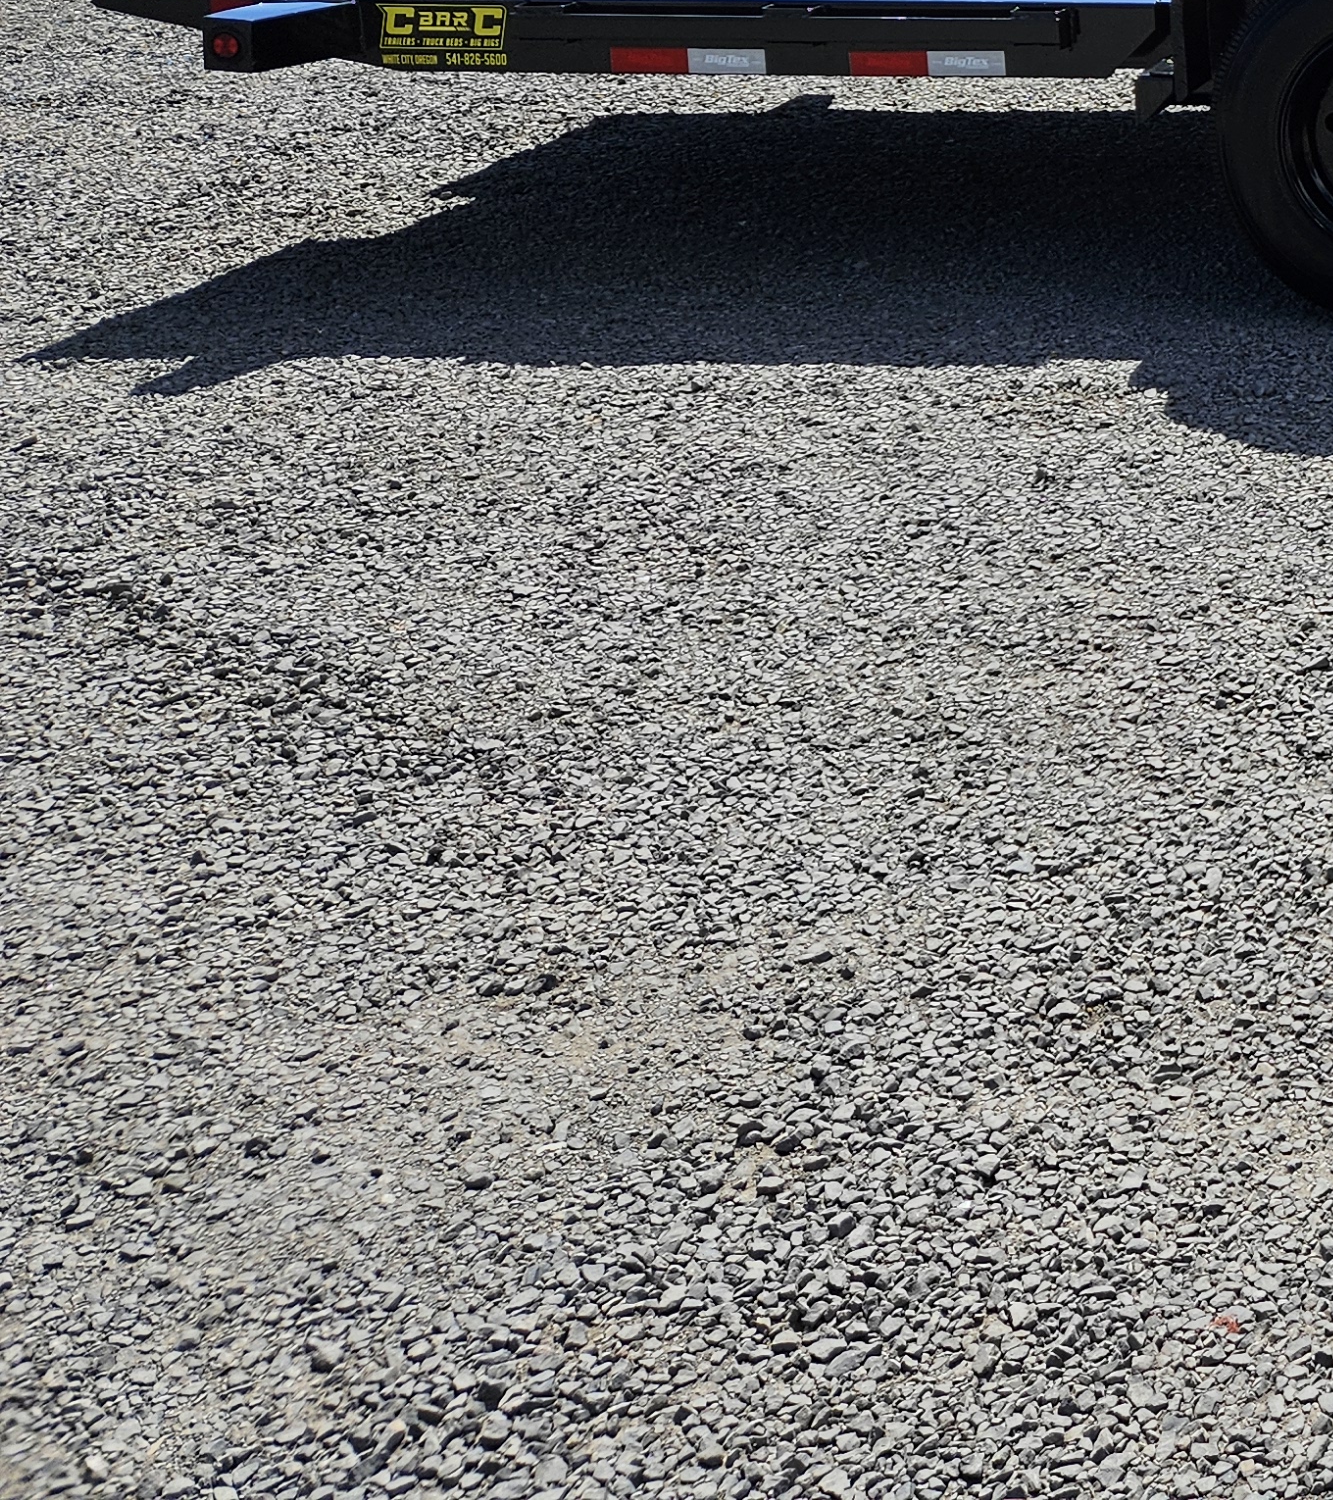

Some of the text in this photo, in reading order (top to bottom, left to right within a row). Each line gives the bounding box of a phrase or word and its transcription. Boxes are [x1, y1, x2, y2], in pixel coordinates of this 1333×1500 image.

[382, 6, 503, 36] C BAR C
[383, 37, 416, 46] TRAILERS
[421, 37, 444, 47] TRUCK
[445, 52, 508, 66] 541-826-5600
[704, 54, 750, 66] BigTex
[943, 56, 990, 68] BigTex
